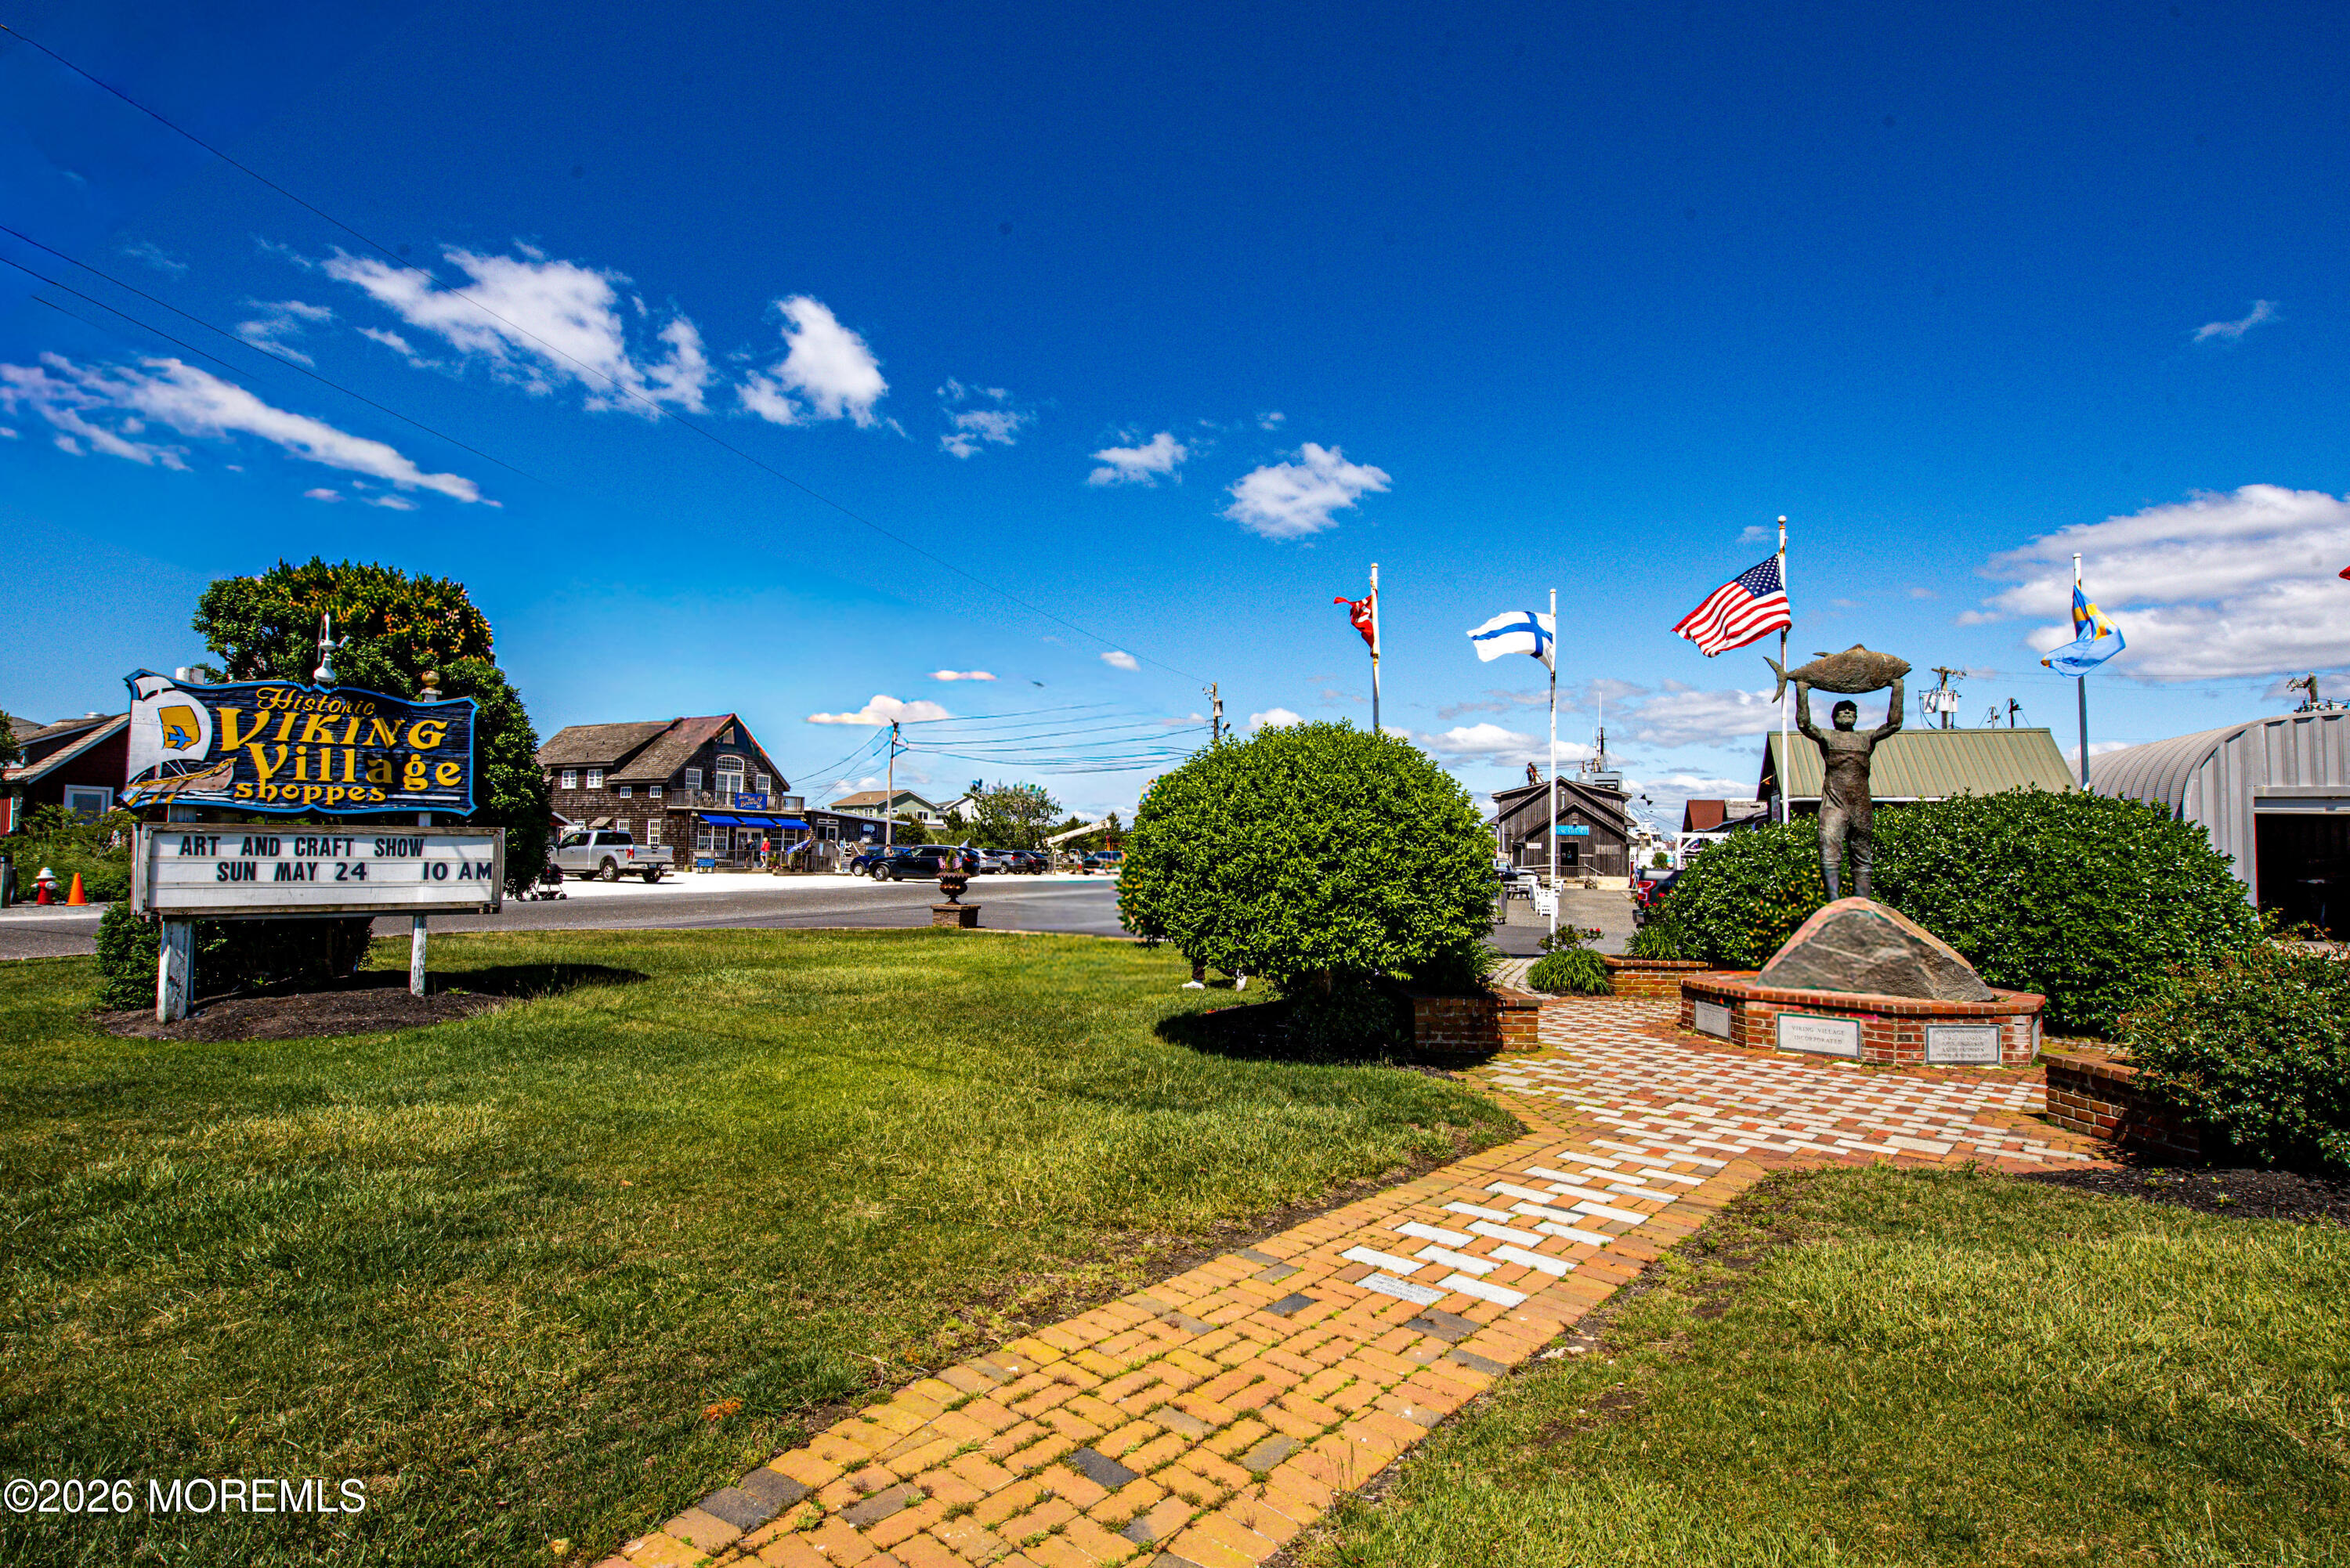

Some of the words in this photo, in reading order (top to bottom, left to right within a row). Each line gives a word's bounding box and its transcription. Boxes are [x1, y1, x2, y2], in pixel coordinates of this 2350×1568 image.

[256, 688, 376, 714] Historic
[216, 707, 449, 751] VIKING
[245, 742, 461, 791] Village
[234, 782, 386, 805] shoppes
[179, 836, 220, 857] ART
[241, 837, 280, 857] AND
[295, 837, 354, 857] CRAFT
[374, 838, 424, 858] SHOW
[217, 862, 256, 882] SUN
[274, 862, 318, 881] MAY
[335, 862, 367, 880] 24
[423, 862, 448, 880] 10
[458, 862, 493, 881] AM
[1794, 1035, 1842, 1046] INCORPORATED
